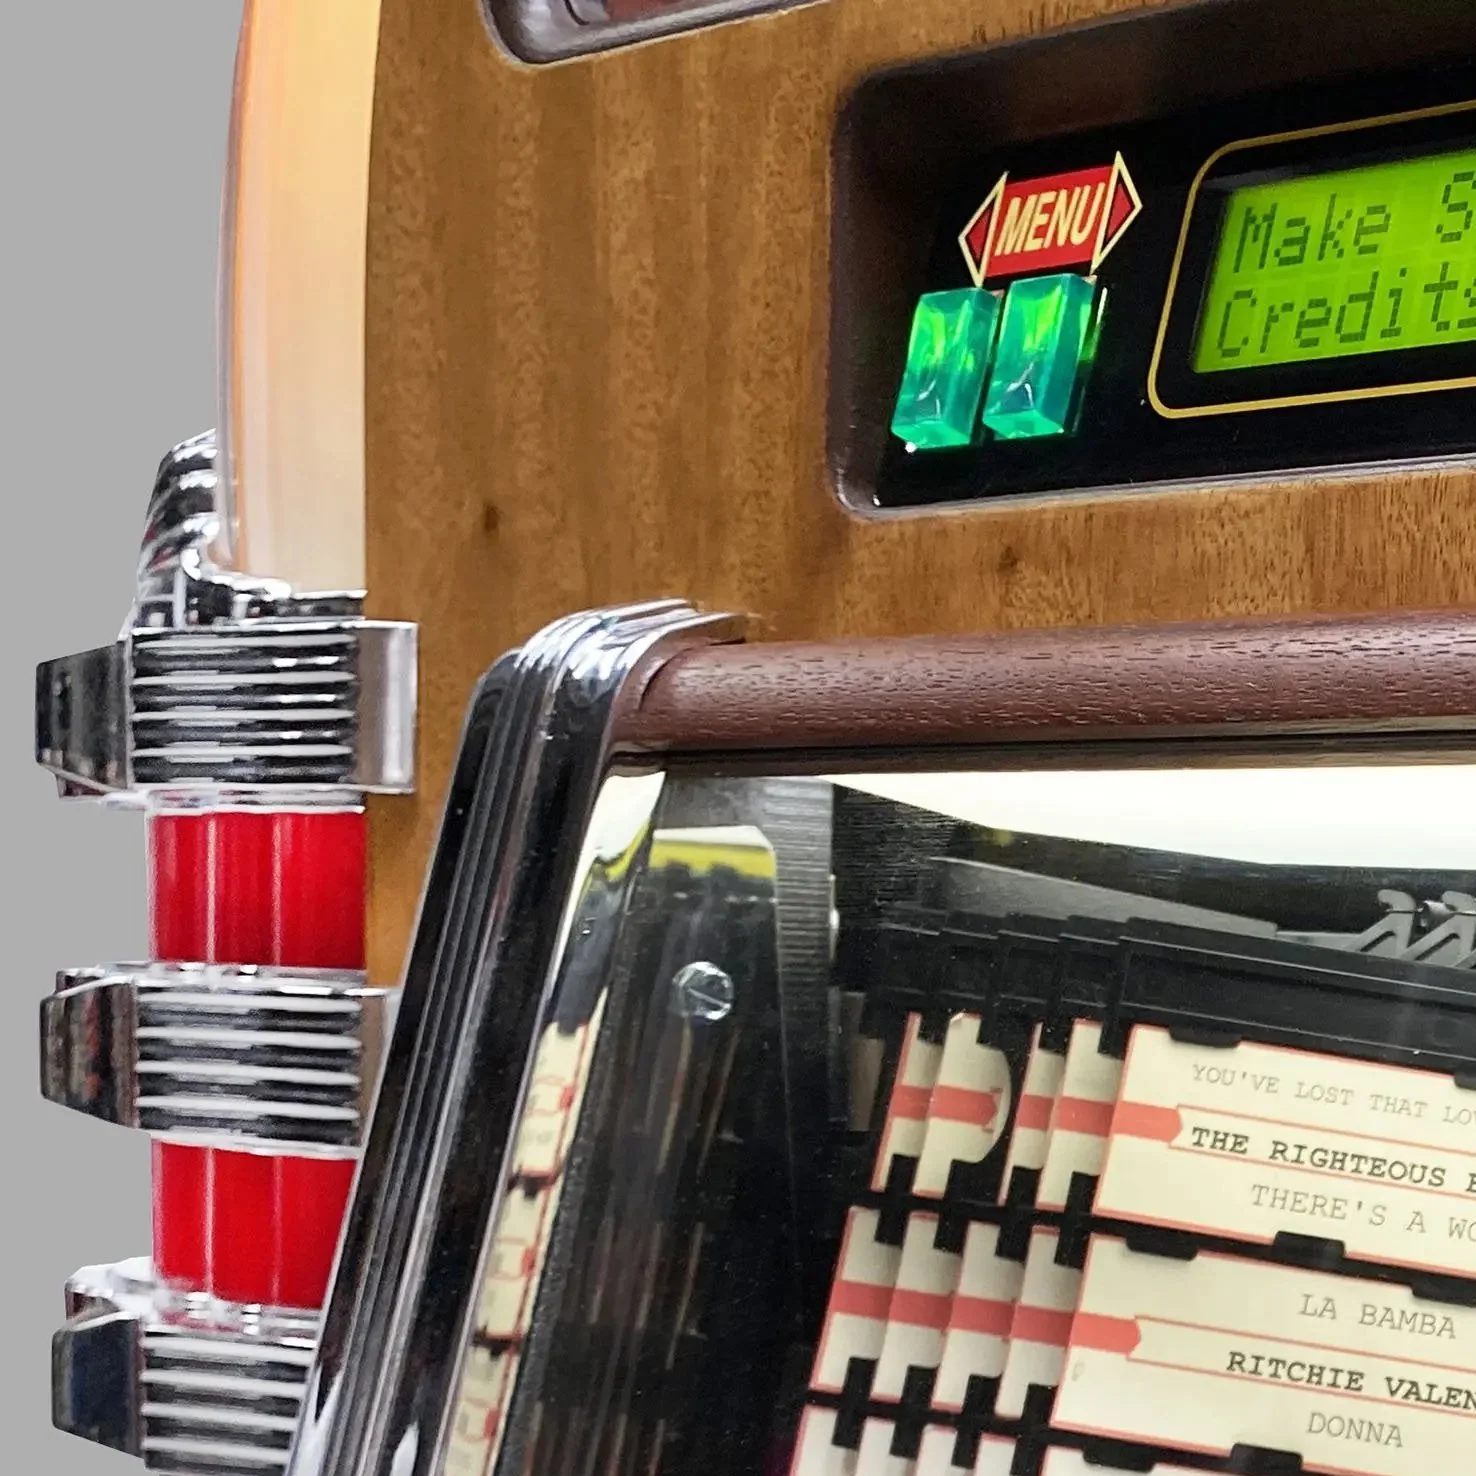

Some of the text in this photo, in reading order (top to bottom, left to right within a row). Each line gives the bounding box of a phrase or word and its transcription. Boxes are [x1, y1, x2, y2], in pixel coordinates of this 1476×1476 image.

[999, 180, 1098, 255] MENU
[1231, 202, 1393, 274] Make
[1192, 1064, 1279, 1095] YOU'VE
[1295, 1079, 1354, 1106] LOST
[1370, 1094, 1428, 1119] THAT
[1192, 1126, 1248, 1157] THE
[1269, 1141, 1446, 1188] RIGHTEOUS
[1251, 1184, 1387, 1227] THERE'S
[1406, 1211, 1427, 1234] A
[1297, 1292, 1458, 1341] LA BAMBA
[1226, 1351, 1365, 1394] RITCHIE
[1307, 1411, 1404, 1450] DONNA
